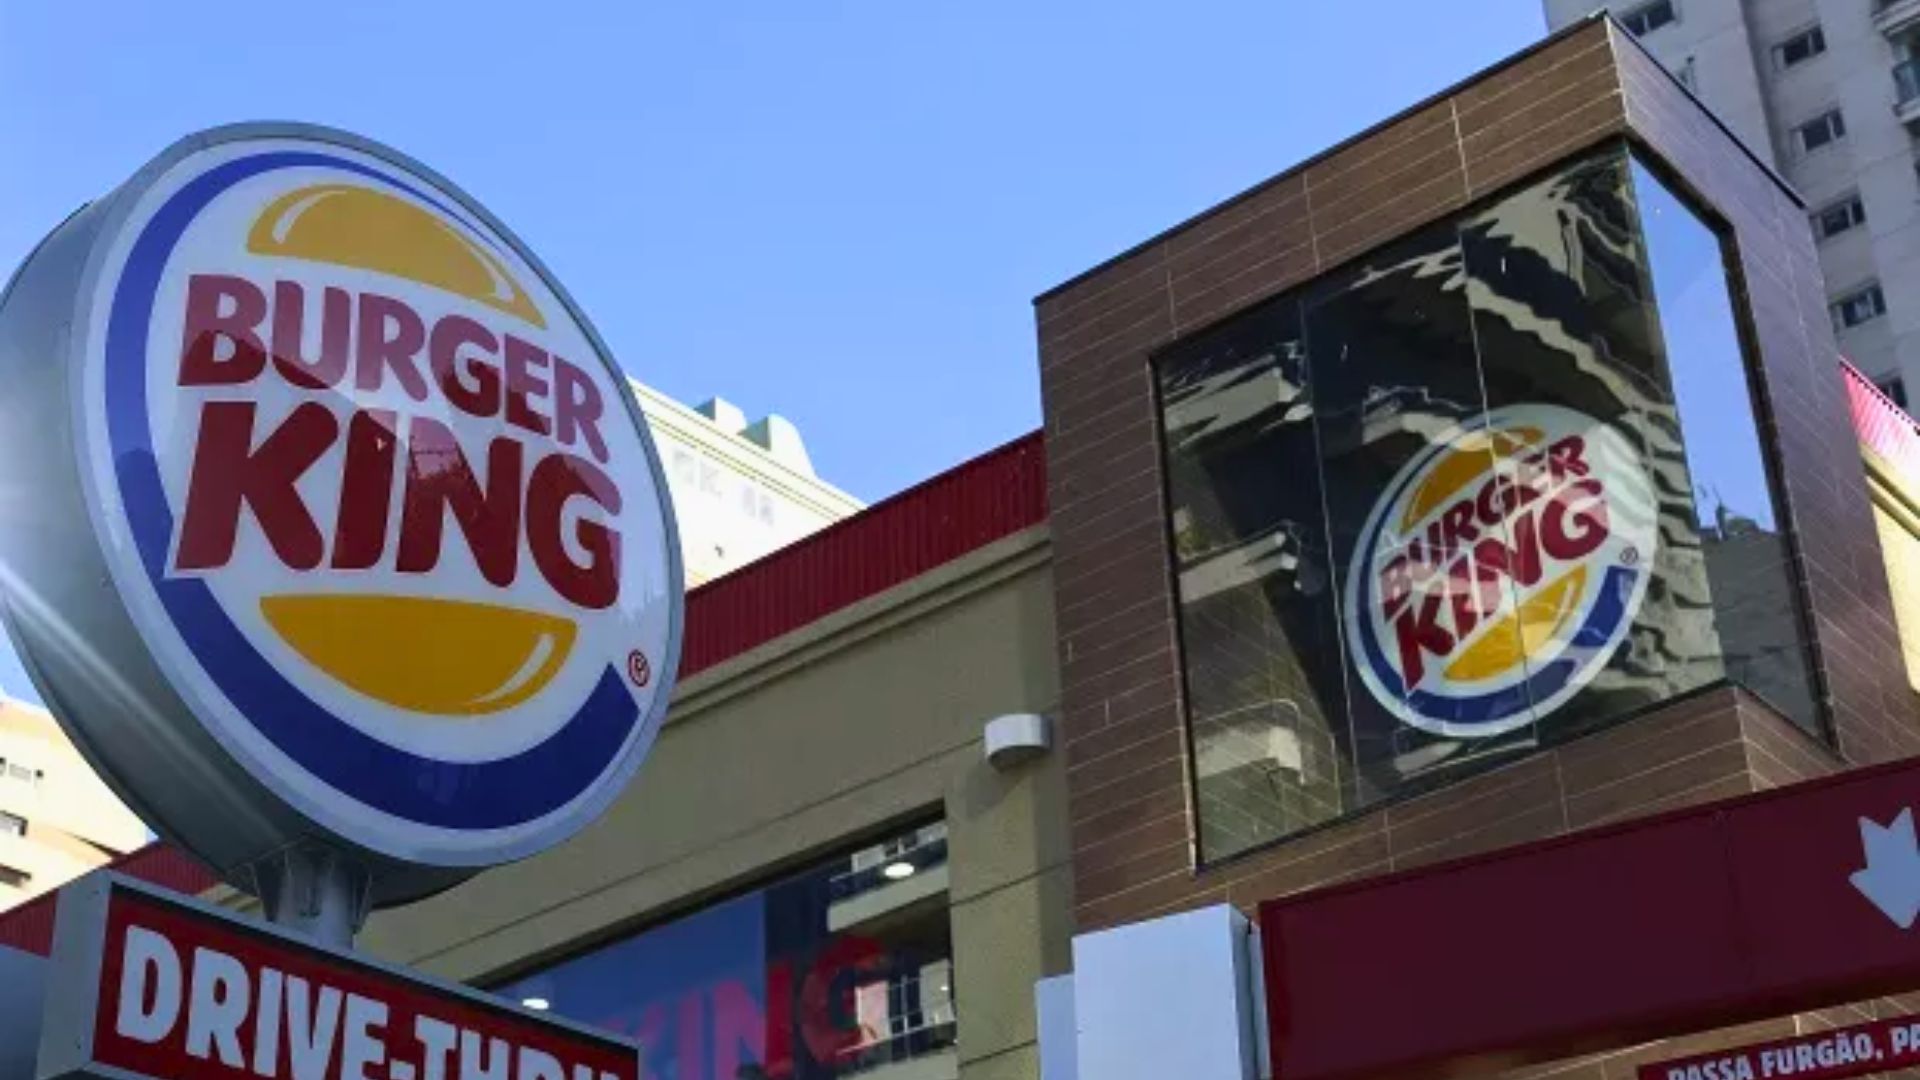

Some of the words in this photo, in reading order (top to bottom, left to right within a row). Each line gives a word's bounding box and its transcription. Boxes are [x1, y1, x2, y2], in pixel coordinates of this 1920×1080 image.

[177, 272, 611, 464] BURGER
[174, 400, 623, 610] KING
[1380, 434, 1590, 623] BURGER
[1396, 478, 1610, 690] KING
[116, 924, 621, 1080] DRIVE-TH
